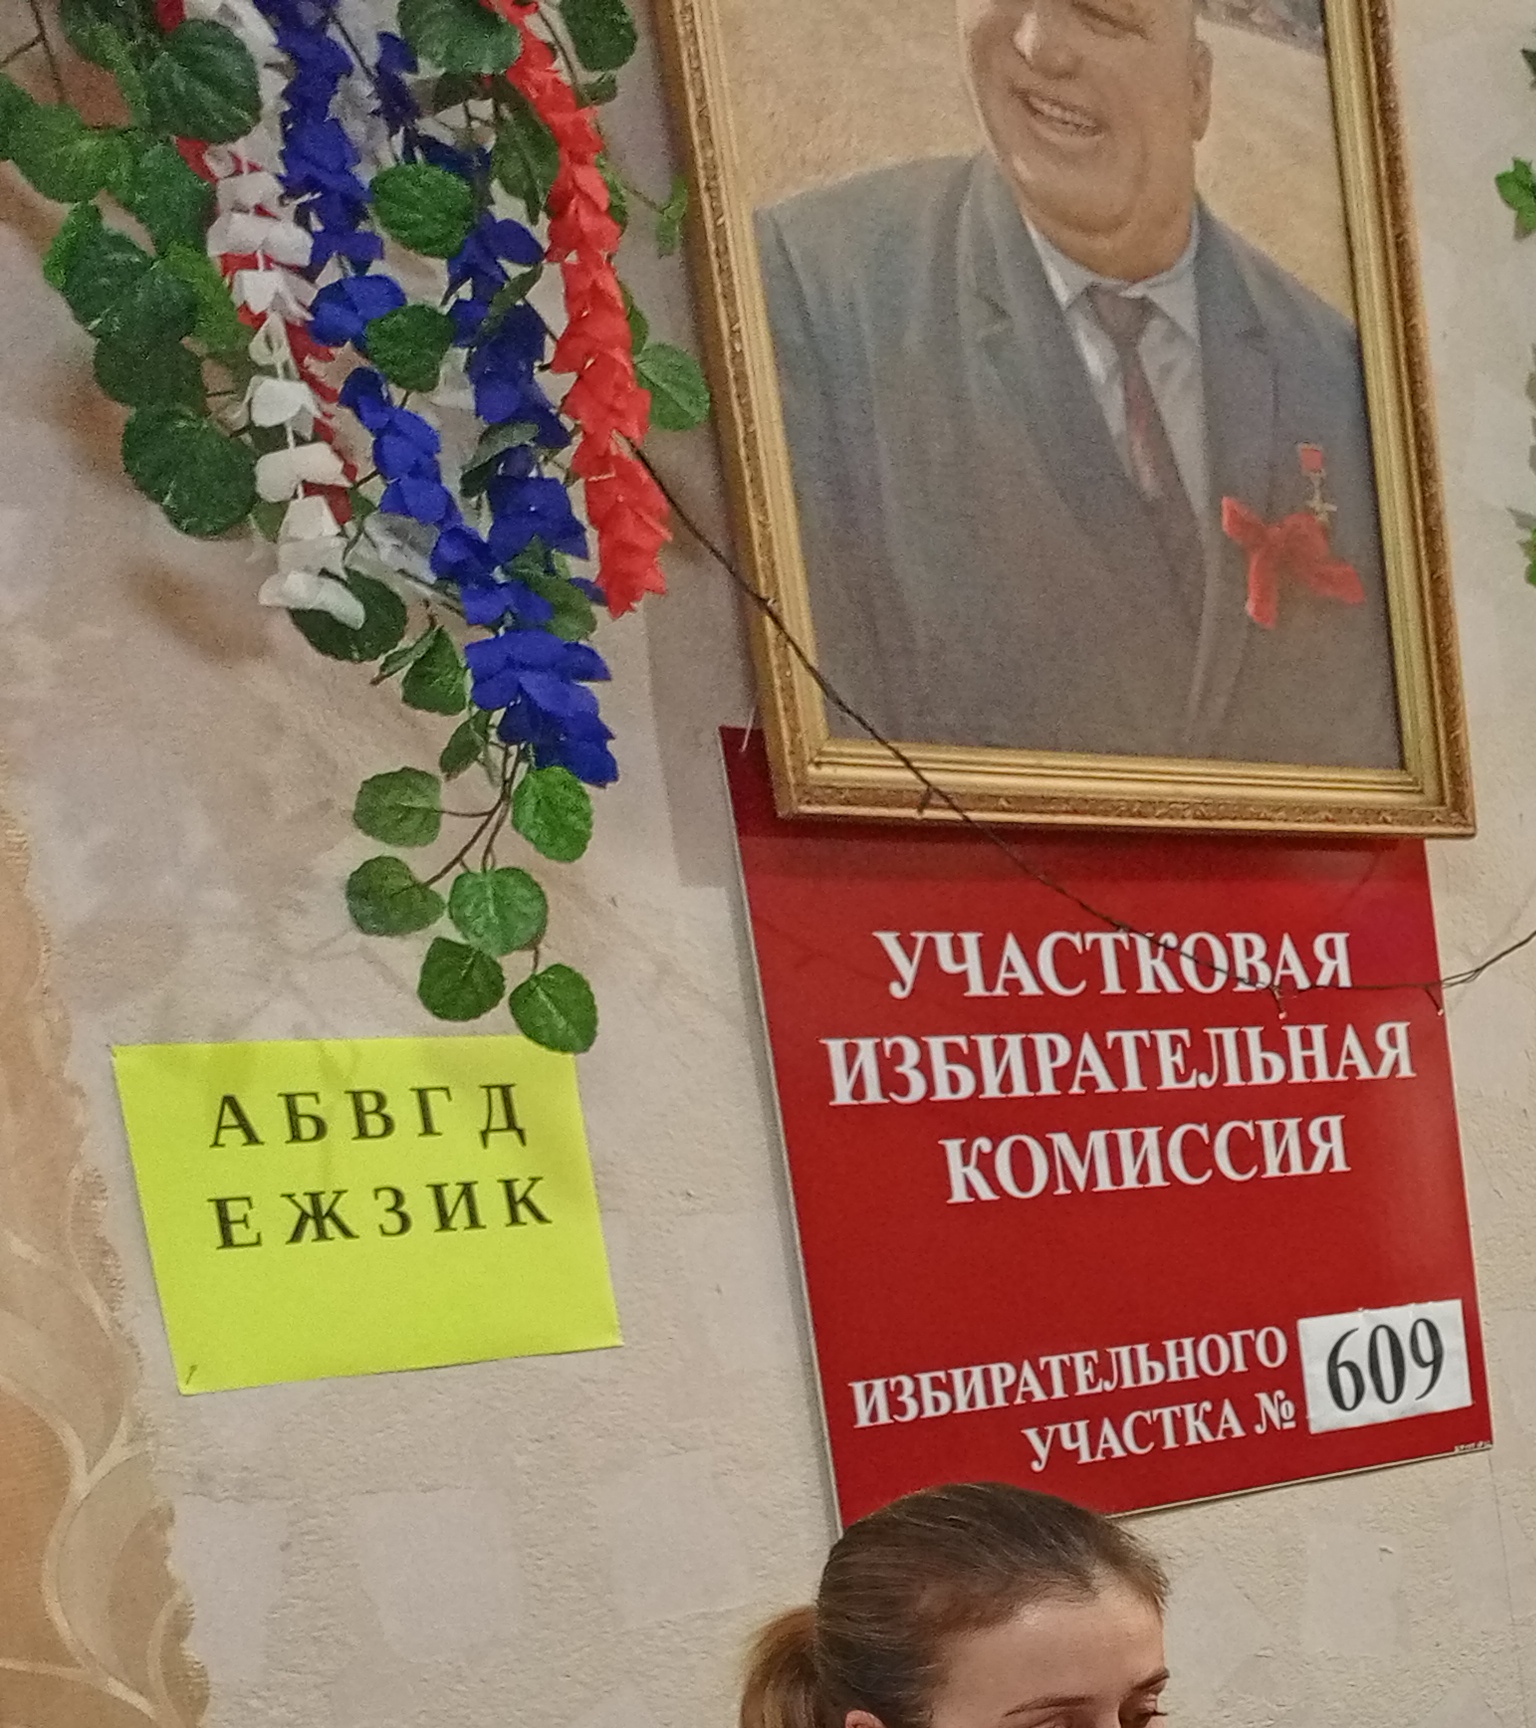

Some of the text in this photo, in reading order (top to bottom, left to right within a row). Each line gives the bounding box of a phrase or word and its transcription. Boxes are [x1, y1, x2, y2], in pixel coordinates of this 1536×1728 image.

[874, 929, 1352, 1001] УЧАСТКОВАЯ
[822, 1018, 1418, 1107] ИЗБИРАТЕЛЬНАЯ
[945, 1116, 1352, 1204] КОМИССИЯ
[851, 1324, 1288, 1428] ИЗБИРАТЕЛЬНОГО
[1022, 1321, 1449, 1472] УЧАСТКА № 609
